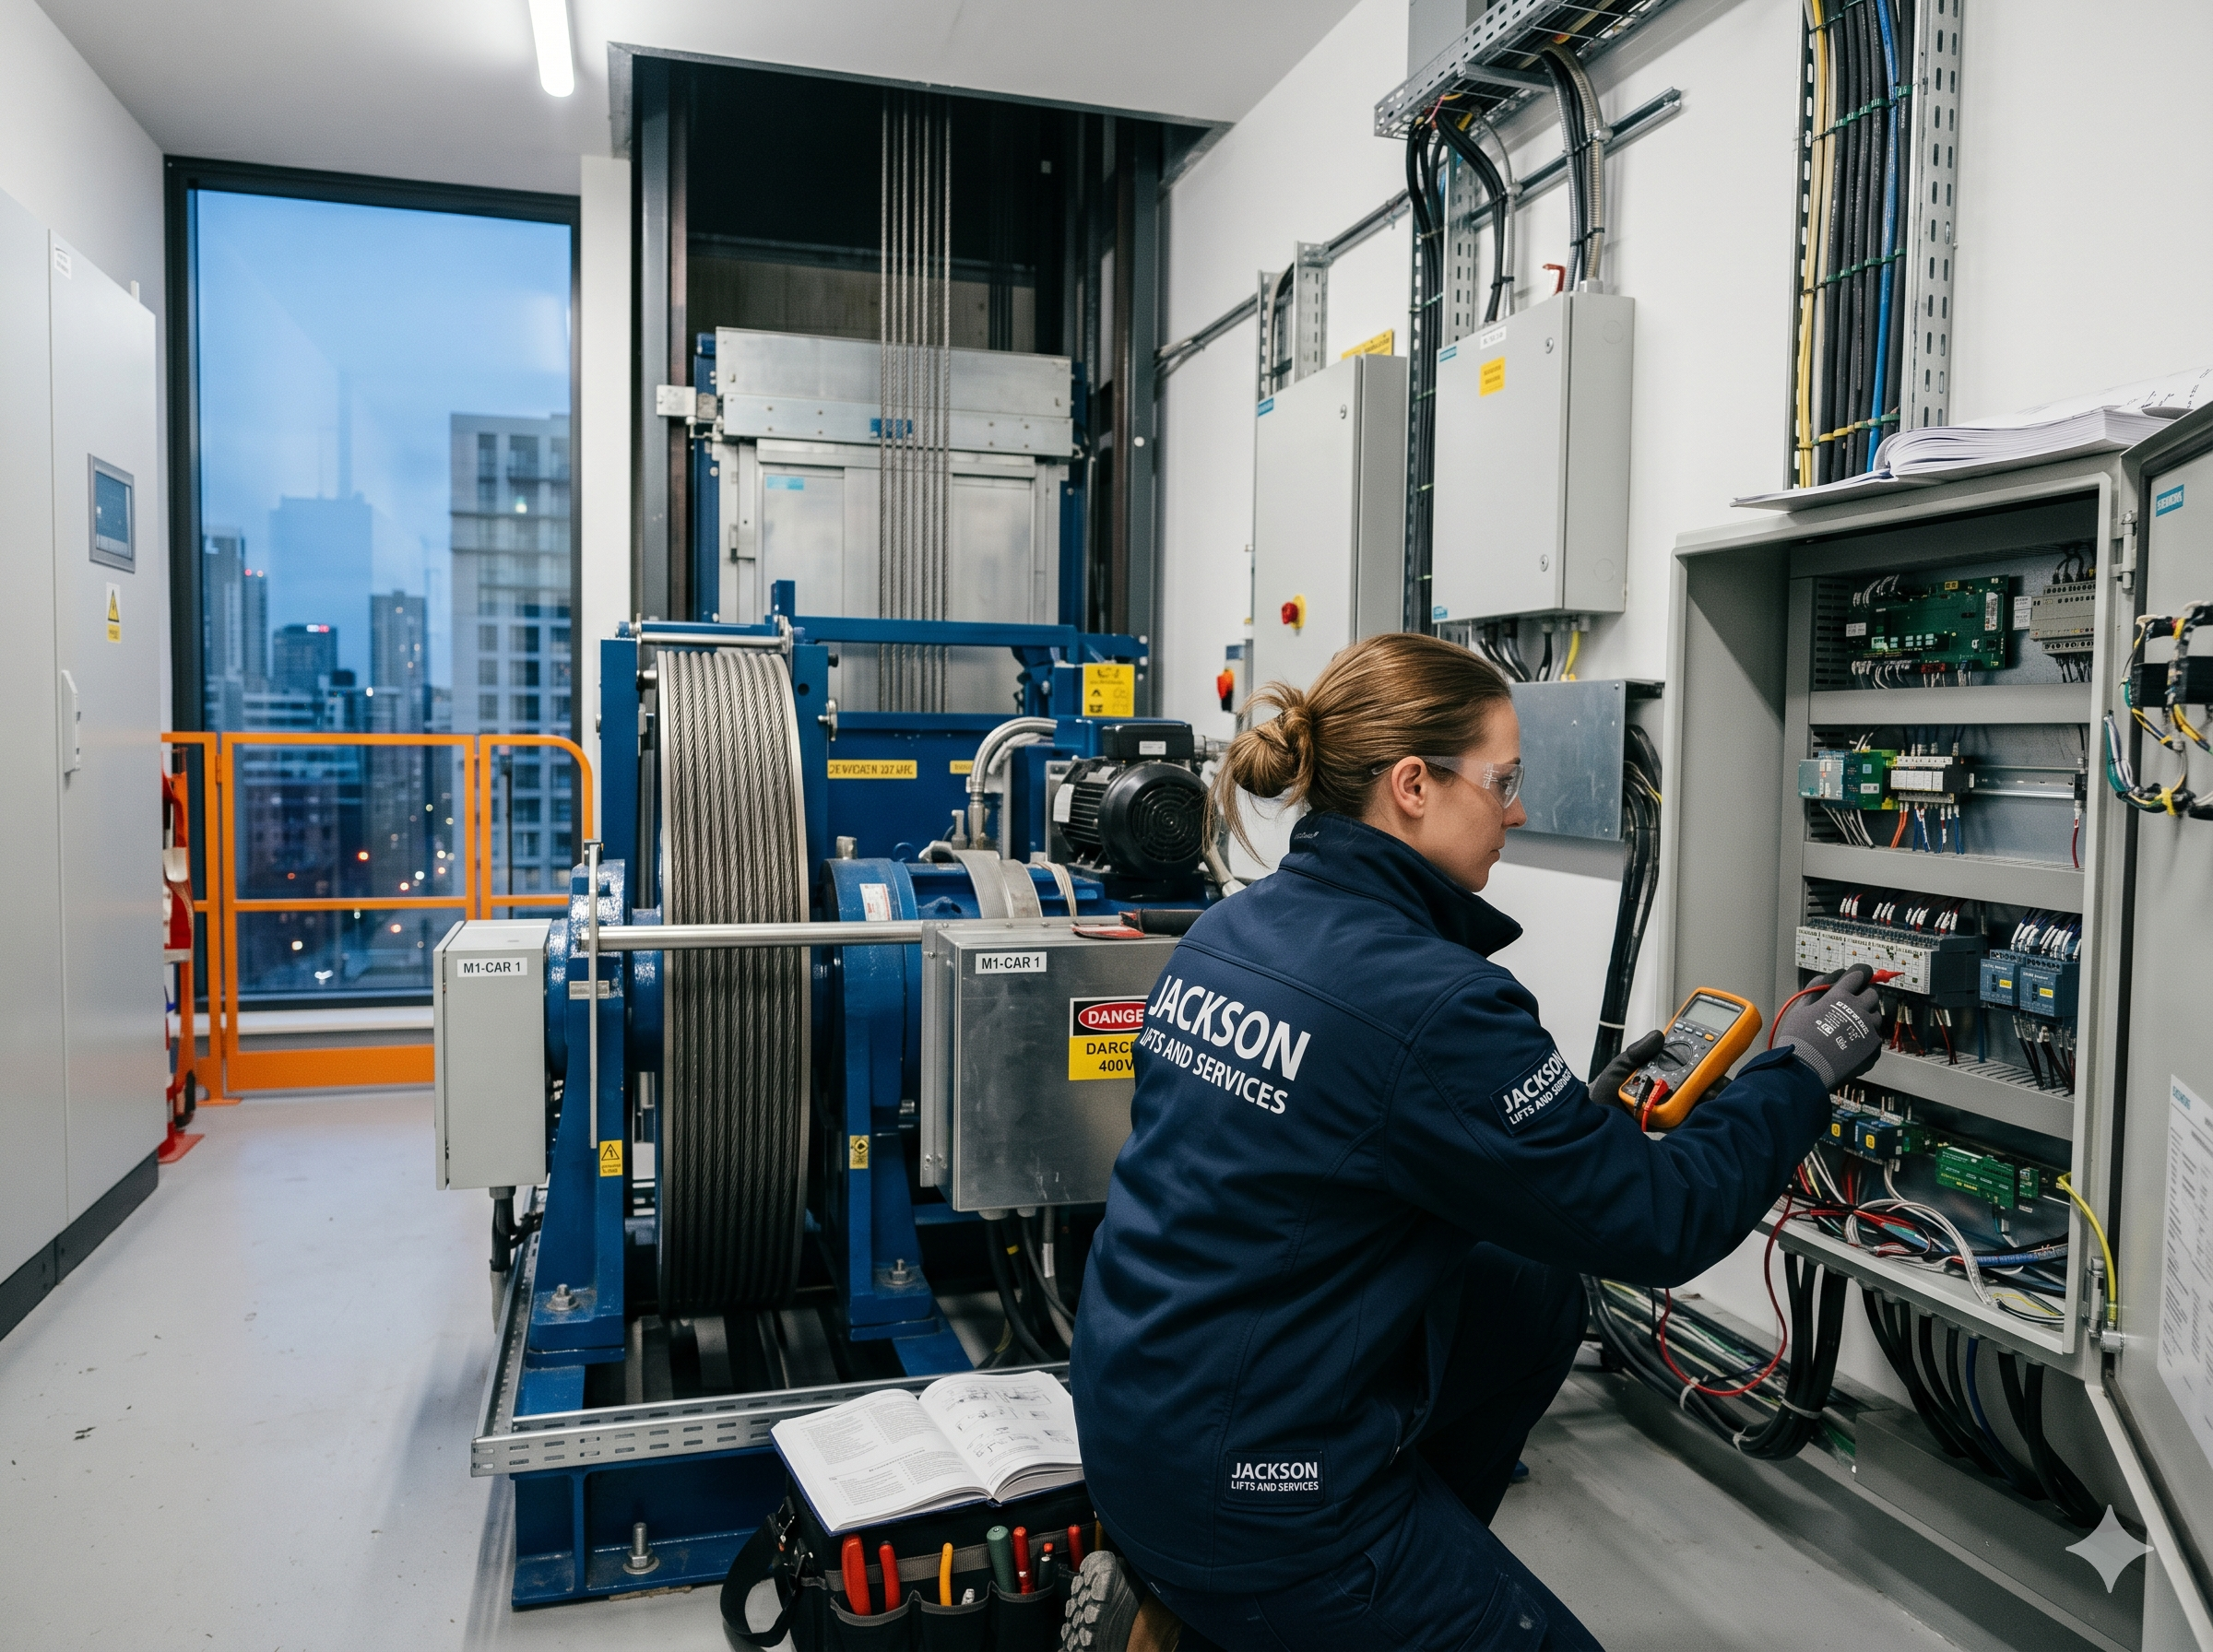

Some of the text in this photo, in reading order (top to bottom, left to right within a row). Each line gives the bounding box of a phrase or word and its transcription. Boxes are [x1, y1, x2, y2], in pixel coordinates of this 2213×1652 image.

[463, 962, 521, 974] M1-CAR 1
[981, 956, 1040, 970] M1-CAR 1
[1087, 1009, 1145, 1025] DANGE
[1148, 974, 1311, 1081] JACKSON
[1086, 1041, 1134, 1056] DARC
[1162, 1037, 1193, 1068] AND
[1192, 1053, 1288, 1115] SERVICES
[1503, 1049, 1565, 1115] JACKSON
[1509, 1104, 1535, 1125] LIFTS
[1534, 1091, 1554, 1110] AND
[1231, 1461, 1319, 1480] JACKSON
[1231, 1480, 1320, 1492] LIFTS AND SERVICES
